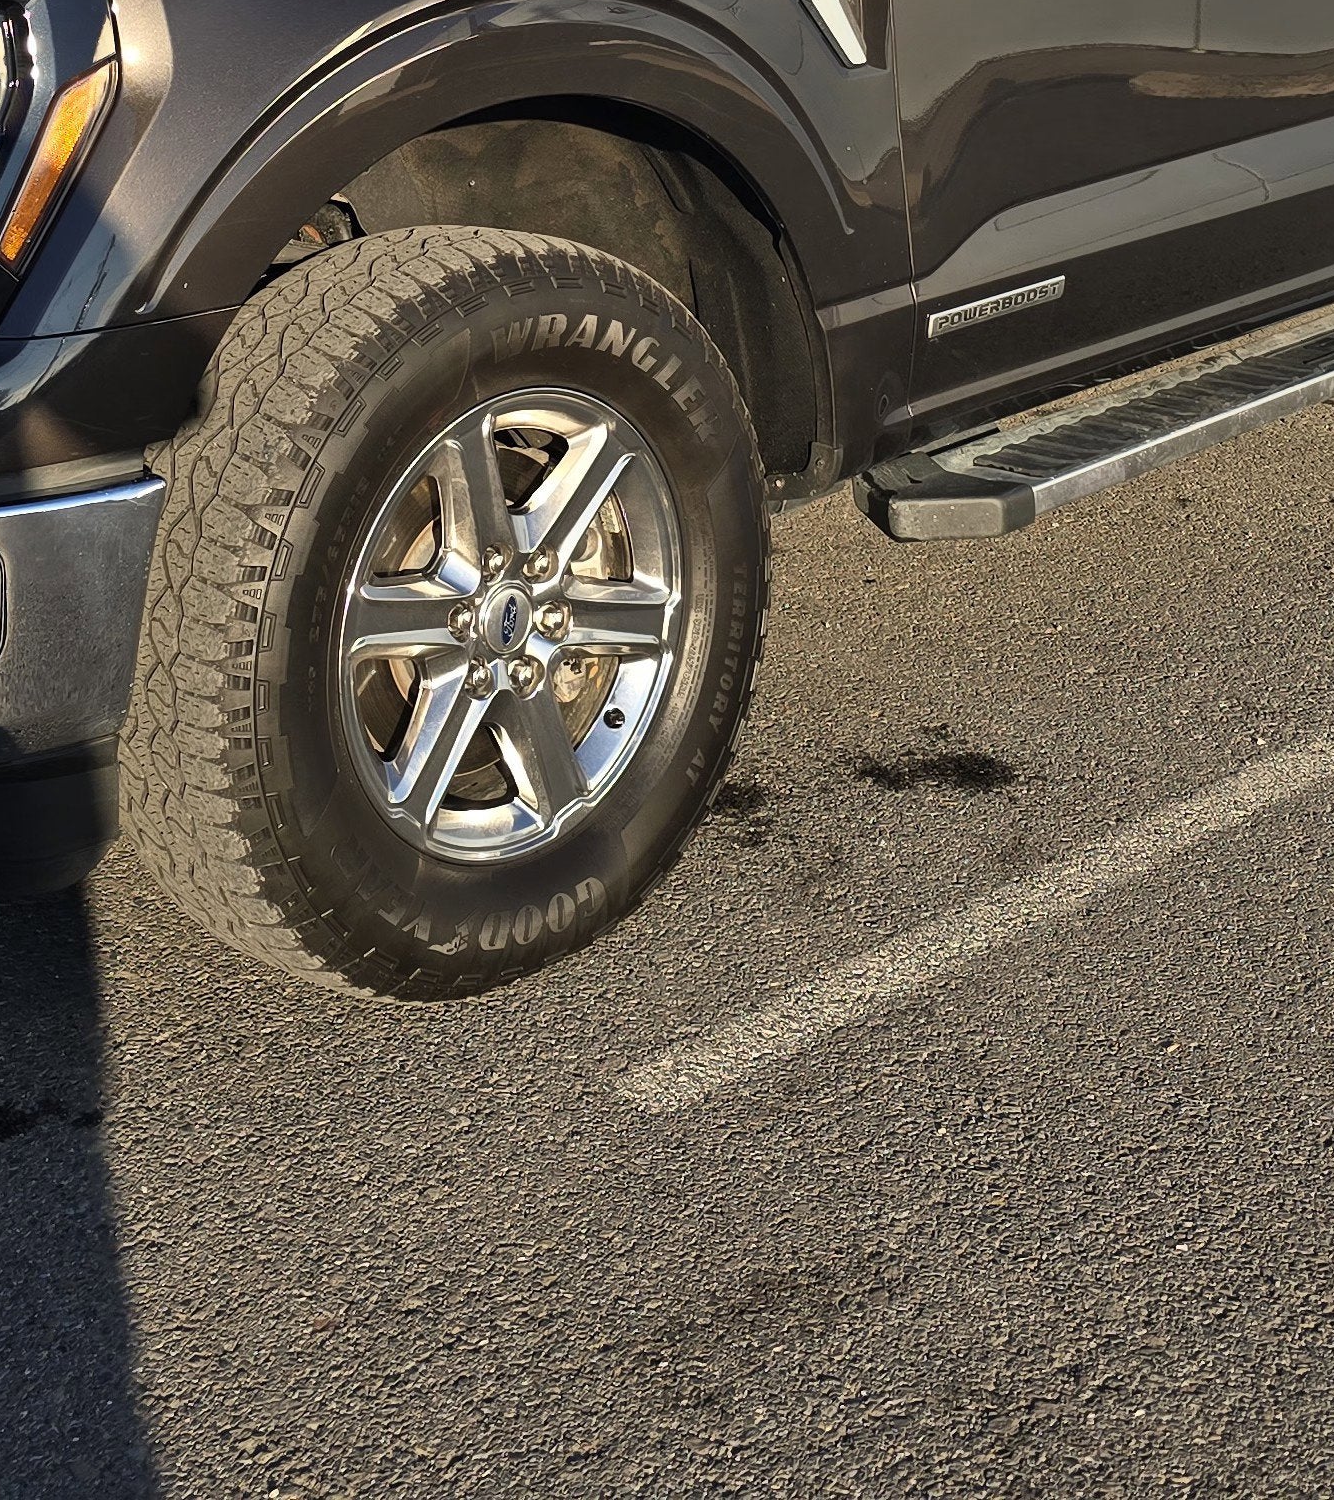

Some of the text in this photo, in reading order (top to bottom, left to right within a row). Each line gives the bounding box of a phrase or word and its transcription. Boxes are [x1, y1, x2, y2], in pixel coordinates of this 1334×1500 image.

[938, 282, 1061, 330] POWERBOOST
[491, 313, 718, 443] WRANGLER
[503, 604, 517, 636] Ford
[685, 561, 748, 788] TERRITORY AT
